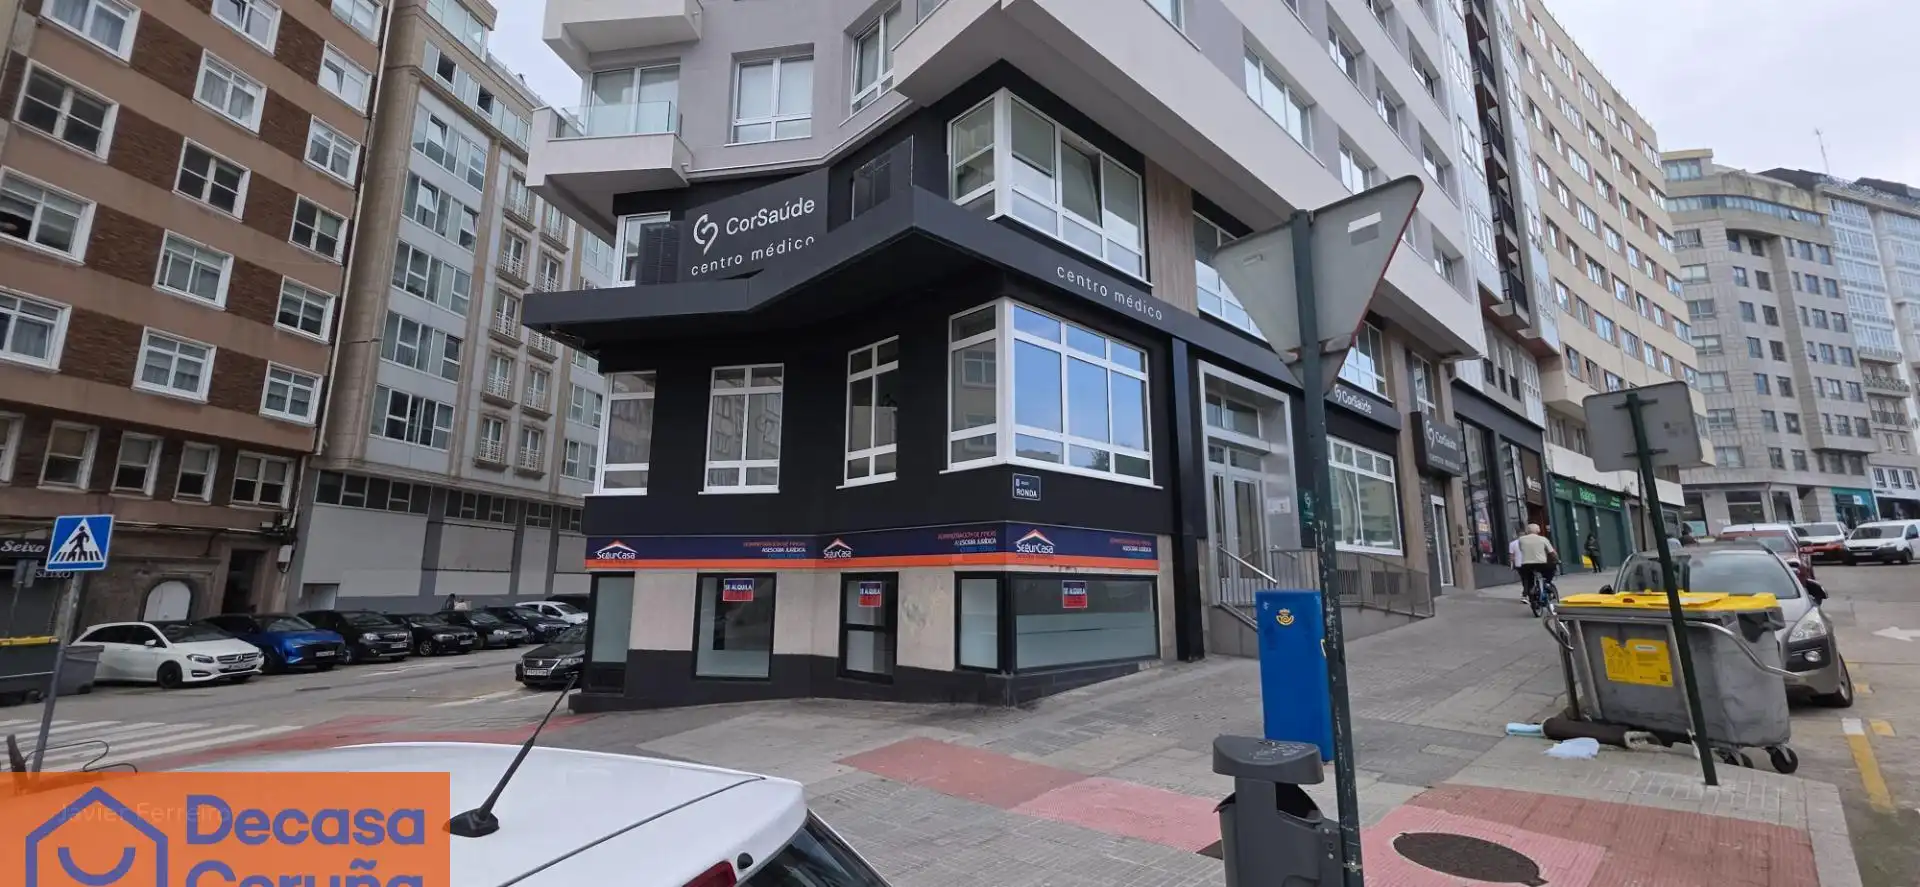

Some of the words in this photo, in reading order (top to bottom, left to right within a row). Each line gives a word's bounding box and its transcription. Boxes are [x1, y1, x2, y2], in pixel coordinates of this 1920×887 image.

[726, 197, 815, 235] CorSaúde
[691, 254, 743, 276] centro
[751, 235, 815, 261] médico
[1057, 266, 1108, 297] centro
[1114, 290, 1163, 321] médico
[1016, 488, 1037, 498] RONDA
[0, 540, 46, 553] Seixo
